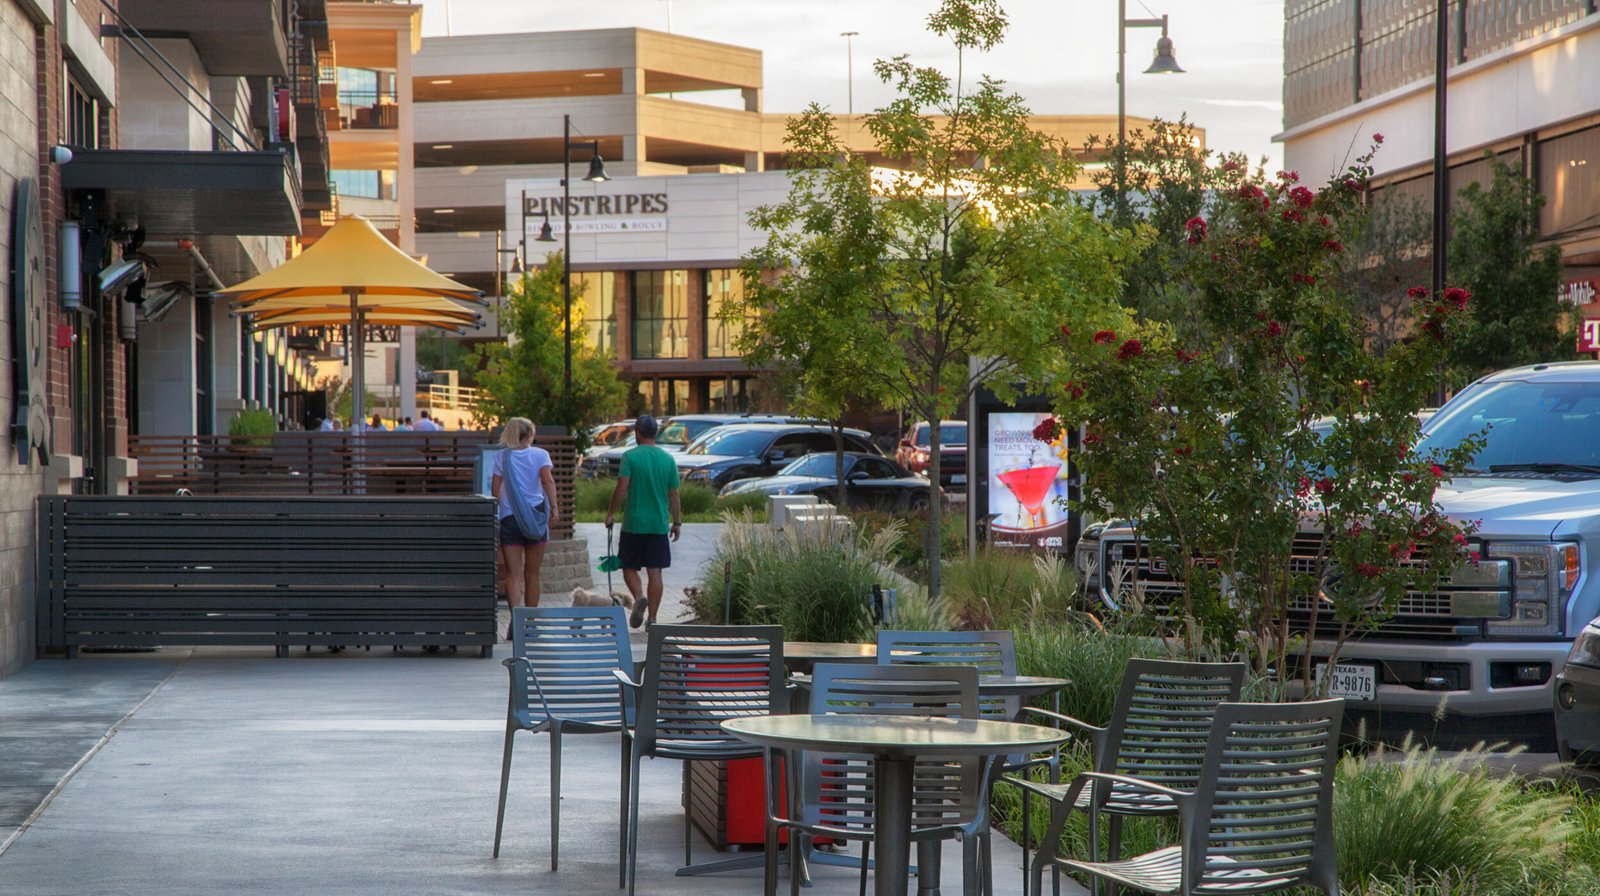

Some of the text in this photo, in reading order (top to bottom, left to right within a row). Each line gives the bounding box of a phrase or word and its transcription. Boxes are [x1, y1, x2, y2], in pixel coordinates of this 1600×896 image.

[525, 193, 668, 216] PINSTRIPES
[575, 223, 617, 231] BOWLING
[632, 222, 663, 230] BOCCE
[1584, 320, 1600, 348] T
